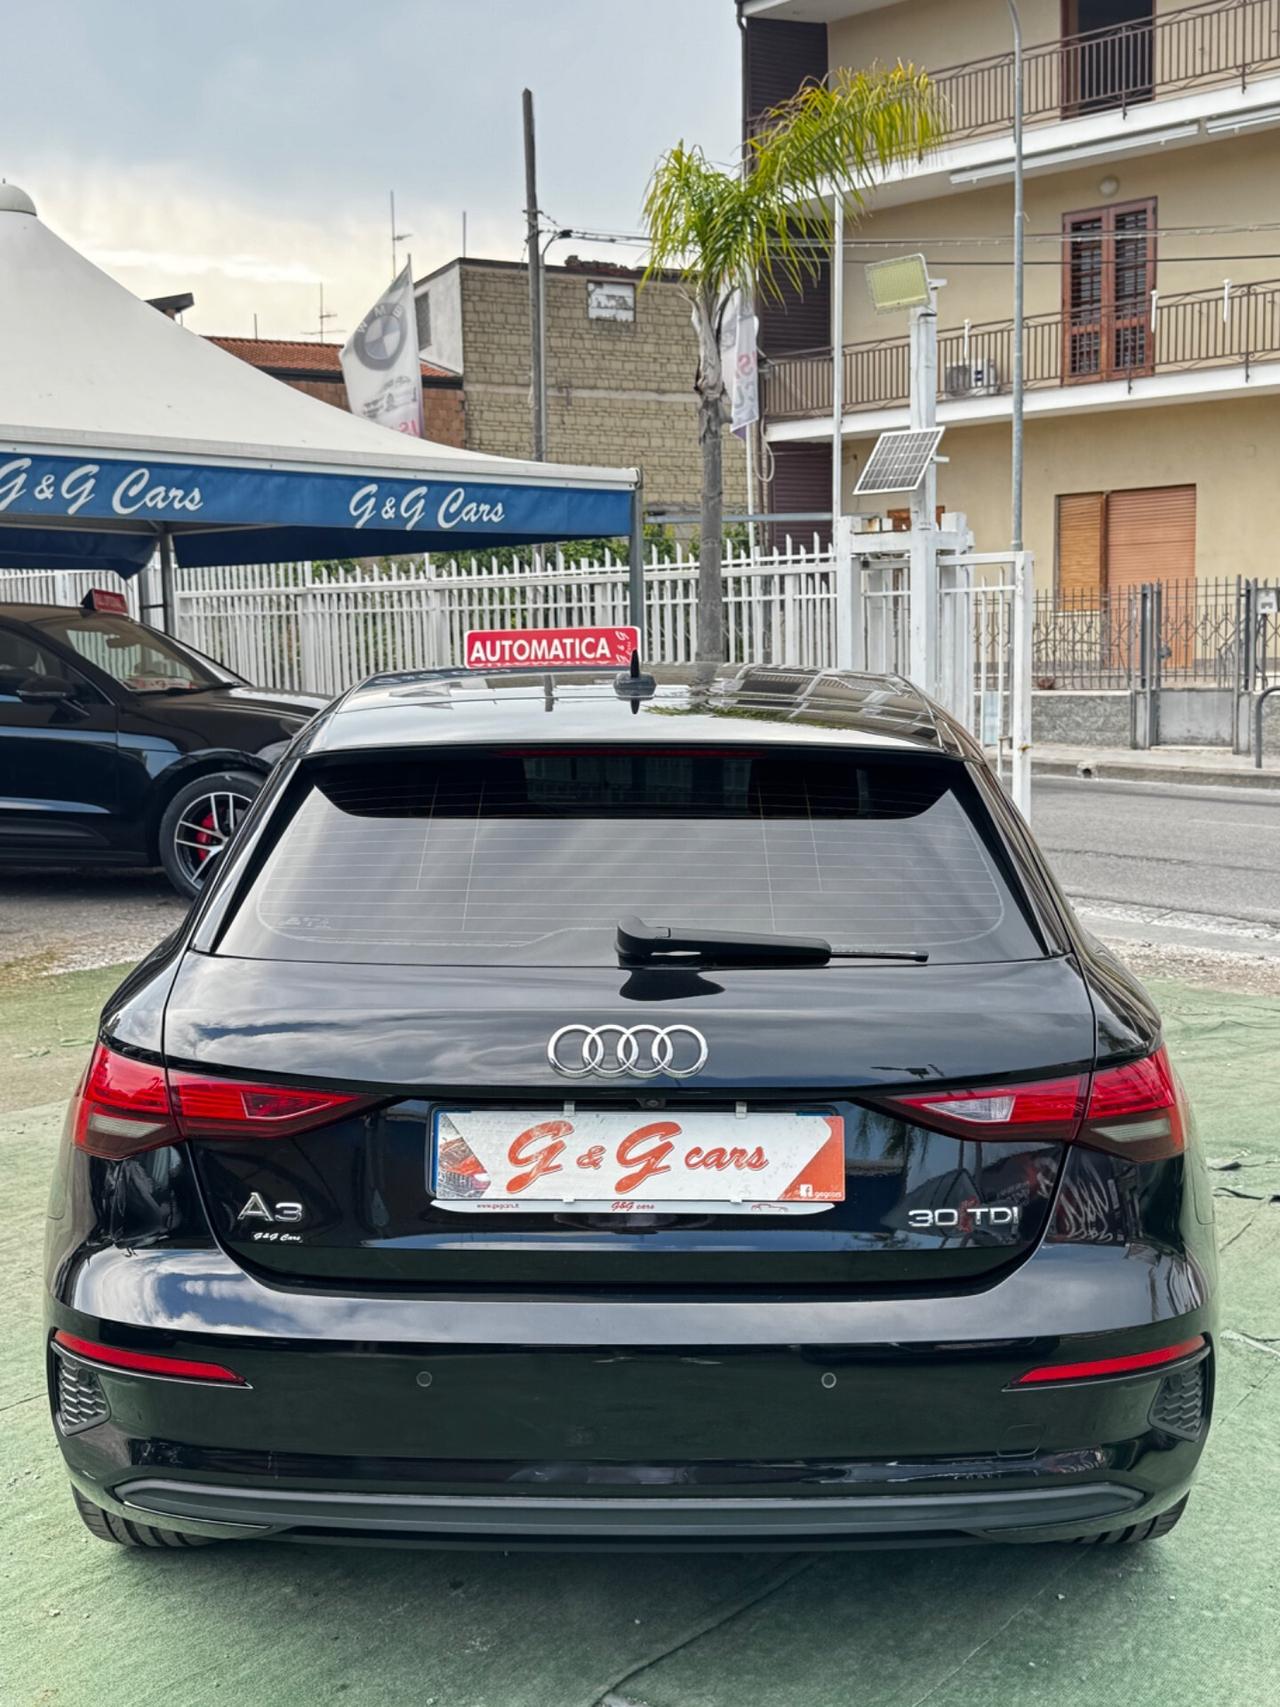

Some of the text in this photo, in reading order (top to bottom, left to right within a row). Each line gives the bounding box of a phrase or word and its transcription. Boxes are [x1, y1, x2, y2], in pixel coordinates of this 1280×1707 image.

[111, 467, 204, 516] Cars
[437, 487, 505, 530] Cars
[470, 637, 612, 662] AUTOMATICA
[684, 1145, 770, 1172] cars
[237, 1192, 303, 1222] A3
[908, 1206, 1019, 1227] 30 TDI
